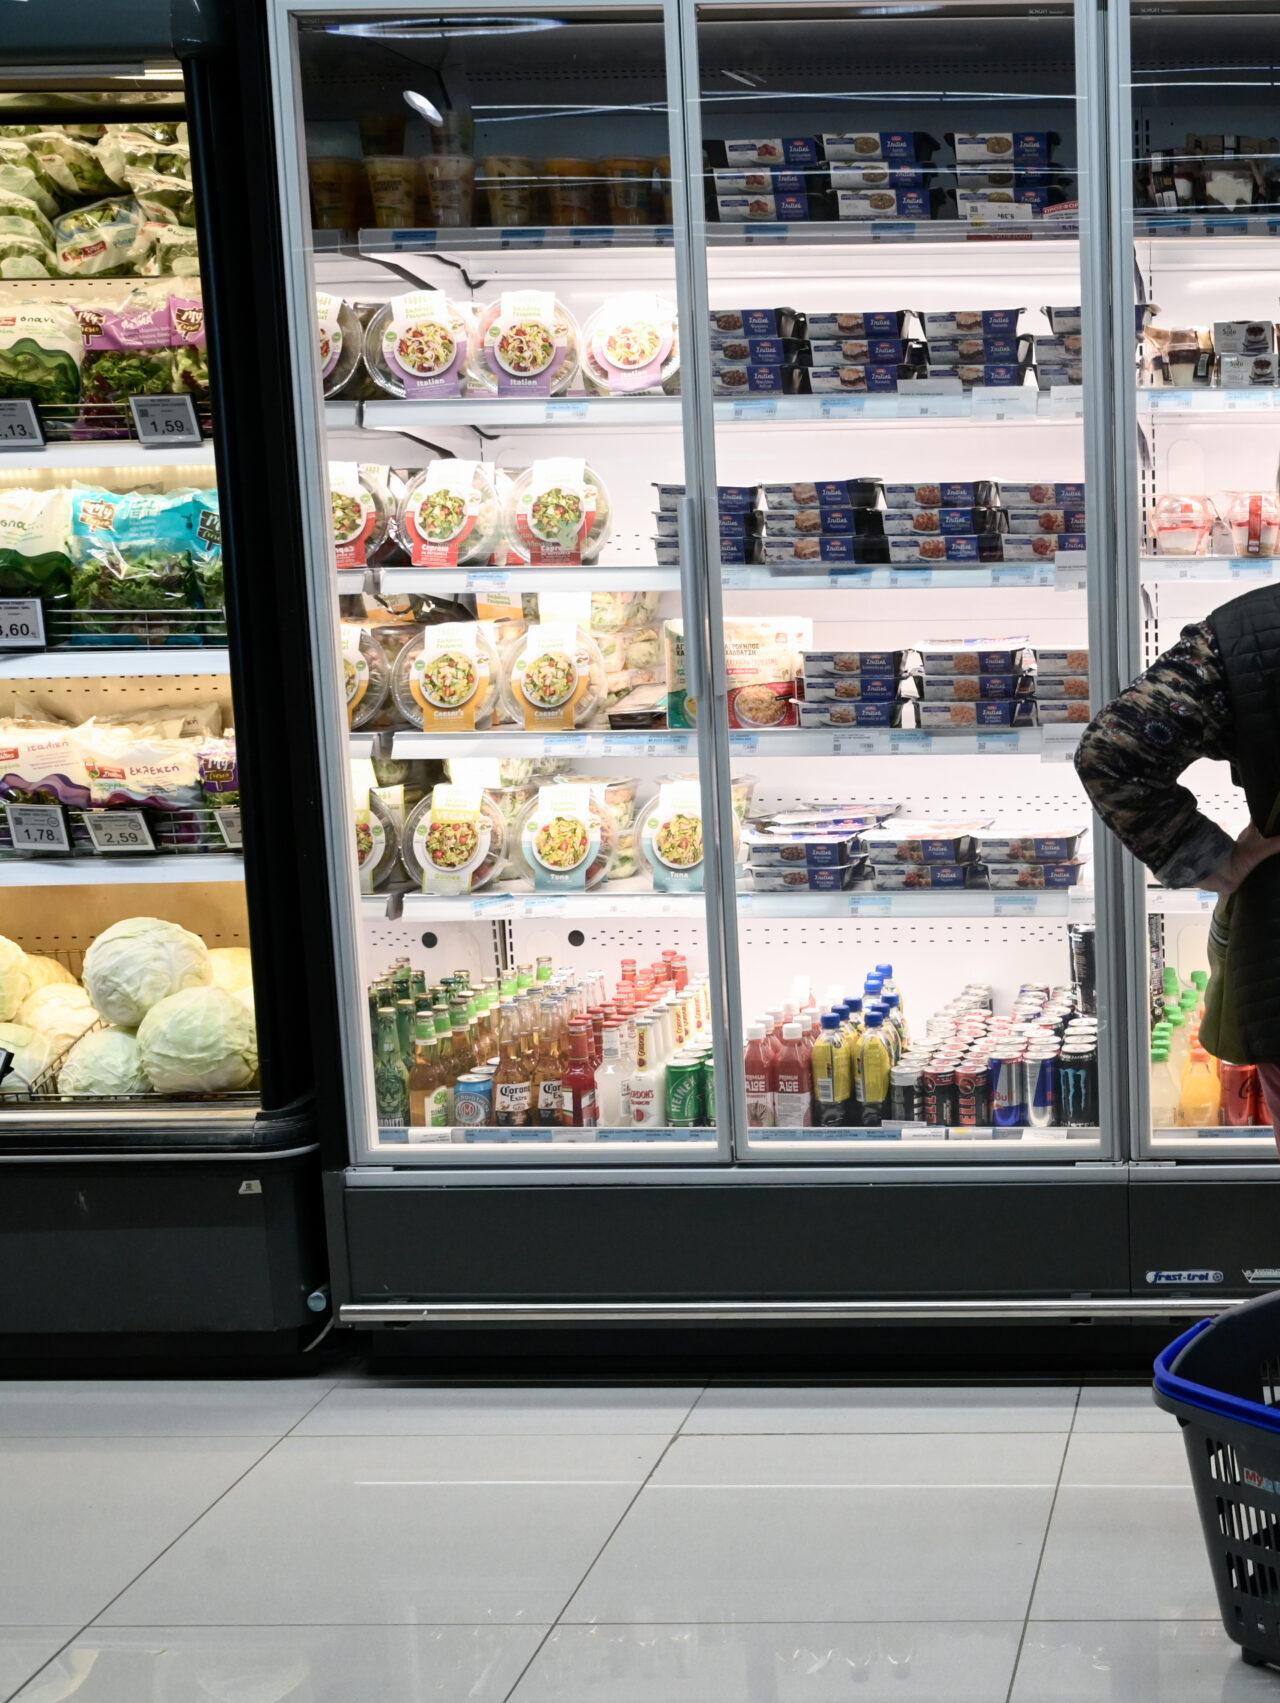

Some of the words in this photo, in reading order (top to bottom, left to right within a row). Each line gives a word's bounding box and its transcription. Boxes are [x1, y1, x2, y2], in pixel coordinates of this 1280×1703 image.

[1043, 202, 1078, 214] ΠΡΟΣΦΟΡ
[417, 378, 445, 387] Italian
[150, 419, 184, 435] 1,59
[24, 829, 55, 842] 1,78
[104, 833, 138, 844] 2,59
[670, 871, 689, 879] Tuna
[745, 1081, 766, 1092] ALOE
[778, 1081, 799, 1092] ALOE
[630, 1089, 654, 1099] ORDON'S
